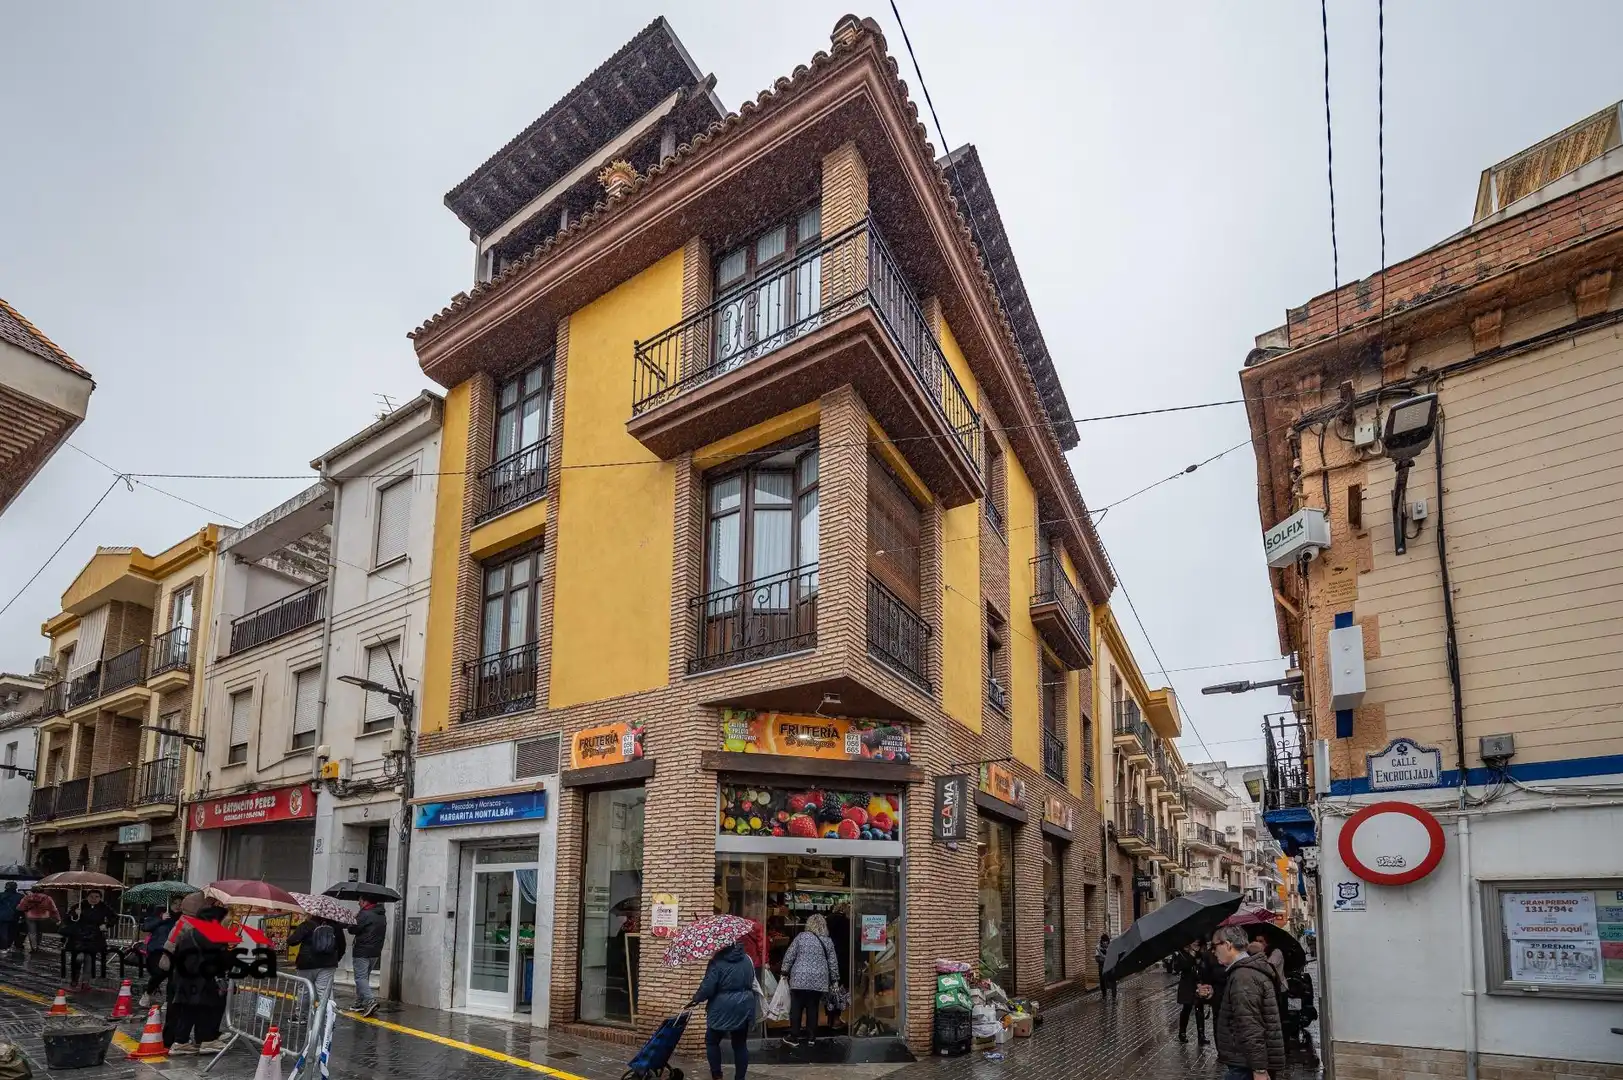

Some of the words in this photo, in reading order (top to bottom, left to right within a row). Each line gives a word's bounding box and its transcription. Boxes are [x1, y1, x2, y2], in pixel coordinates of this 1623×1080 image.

[1267, 518, 1304, 549] SOLFIX
[781, 723, 840, 739] FRUTERÍA
[1391, 757, 1417, 767] CALLE
[1376, 769, 1434, 783] ENCRUCIJADA
[215, 804, 222, 815] EL
[452, 802, 475, 810] Pescados
[942, 781, 955, 837] ECAMA
[364, 808, 369, 817] 2
[440, 812, 474, 821] MARGARITA
[475, 807, 514, 819] MONTALBÁN
[1561, 925, 1583, 933] AQUÍ
